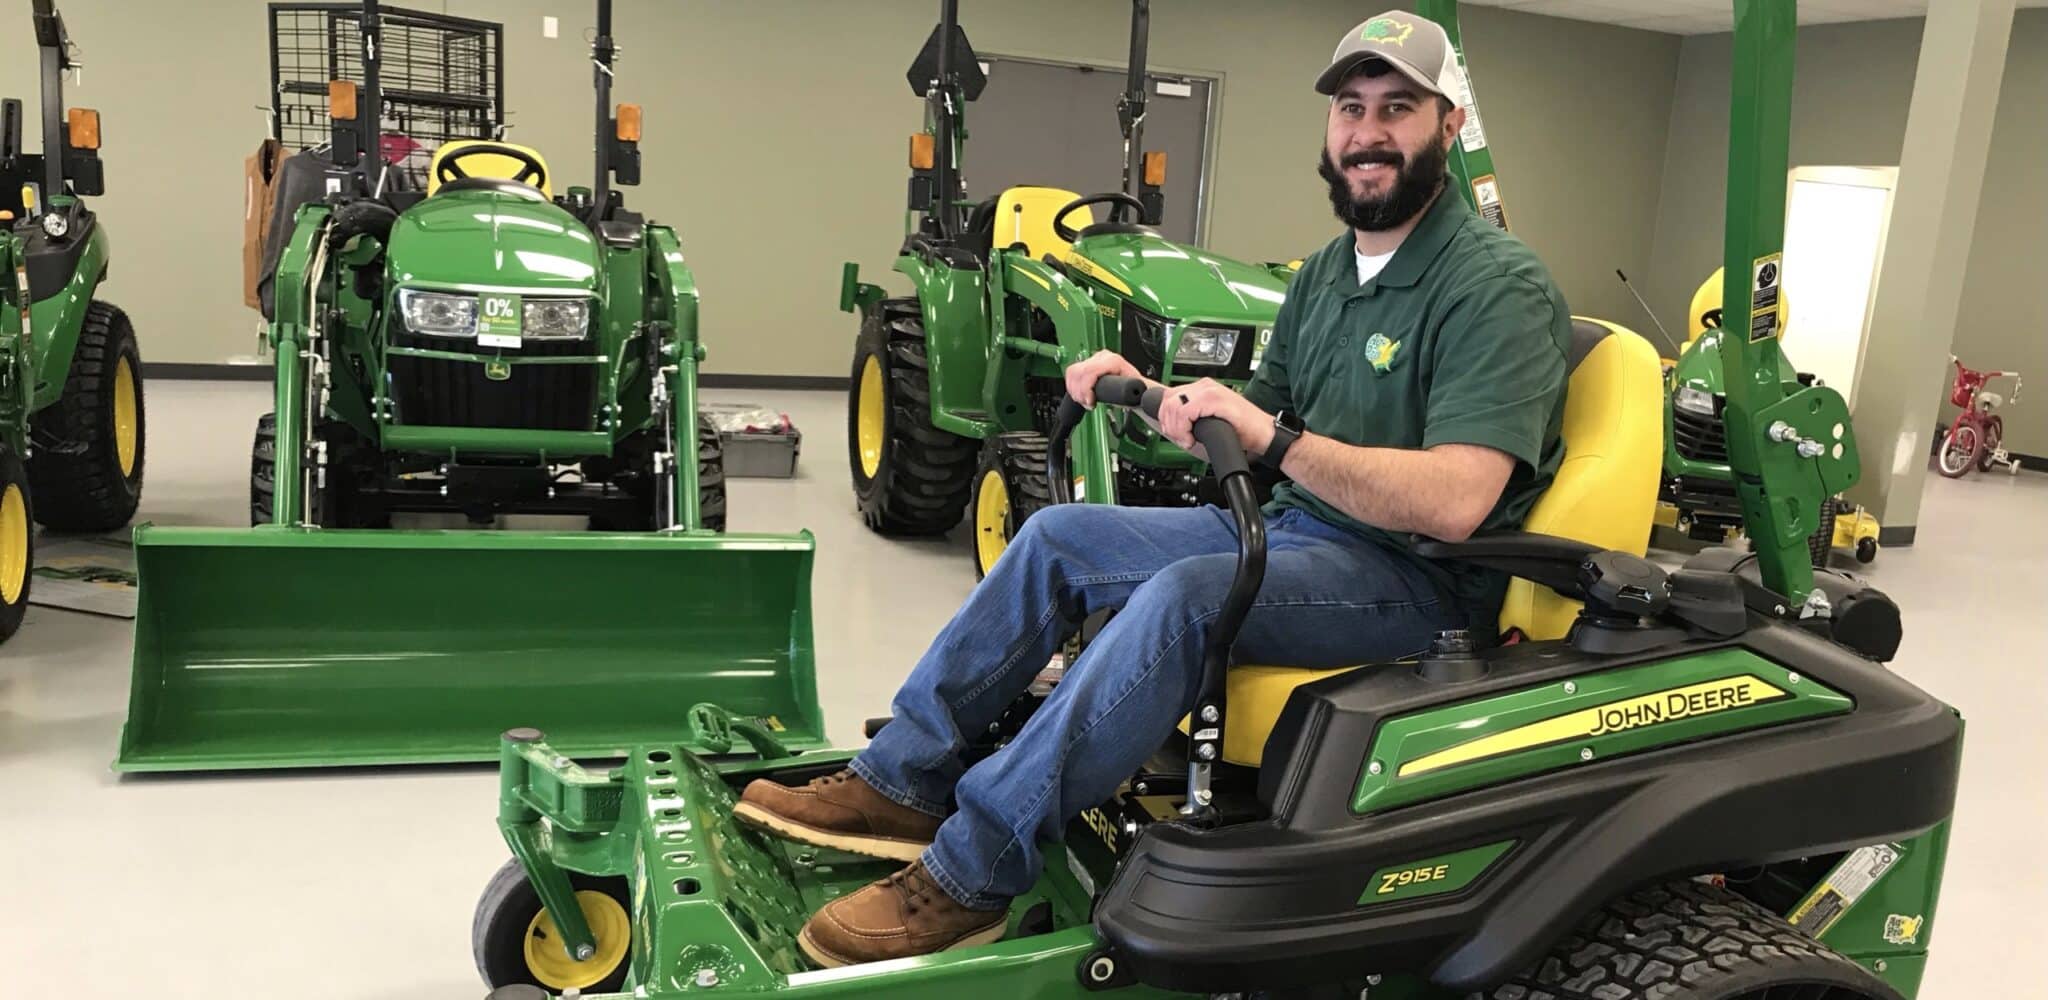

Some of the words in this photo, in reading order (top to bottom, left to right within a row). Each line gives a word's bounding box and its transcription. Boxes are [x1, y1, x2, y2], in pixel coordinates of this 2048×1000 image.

[485, 298, 513, 317] 0%
[1590, 702, 1661, 733] JOHN
[1667, 684, 1752, 716] DEERE
